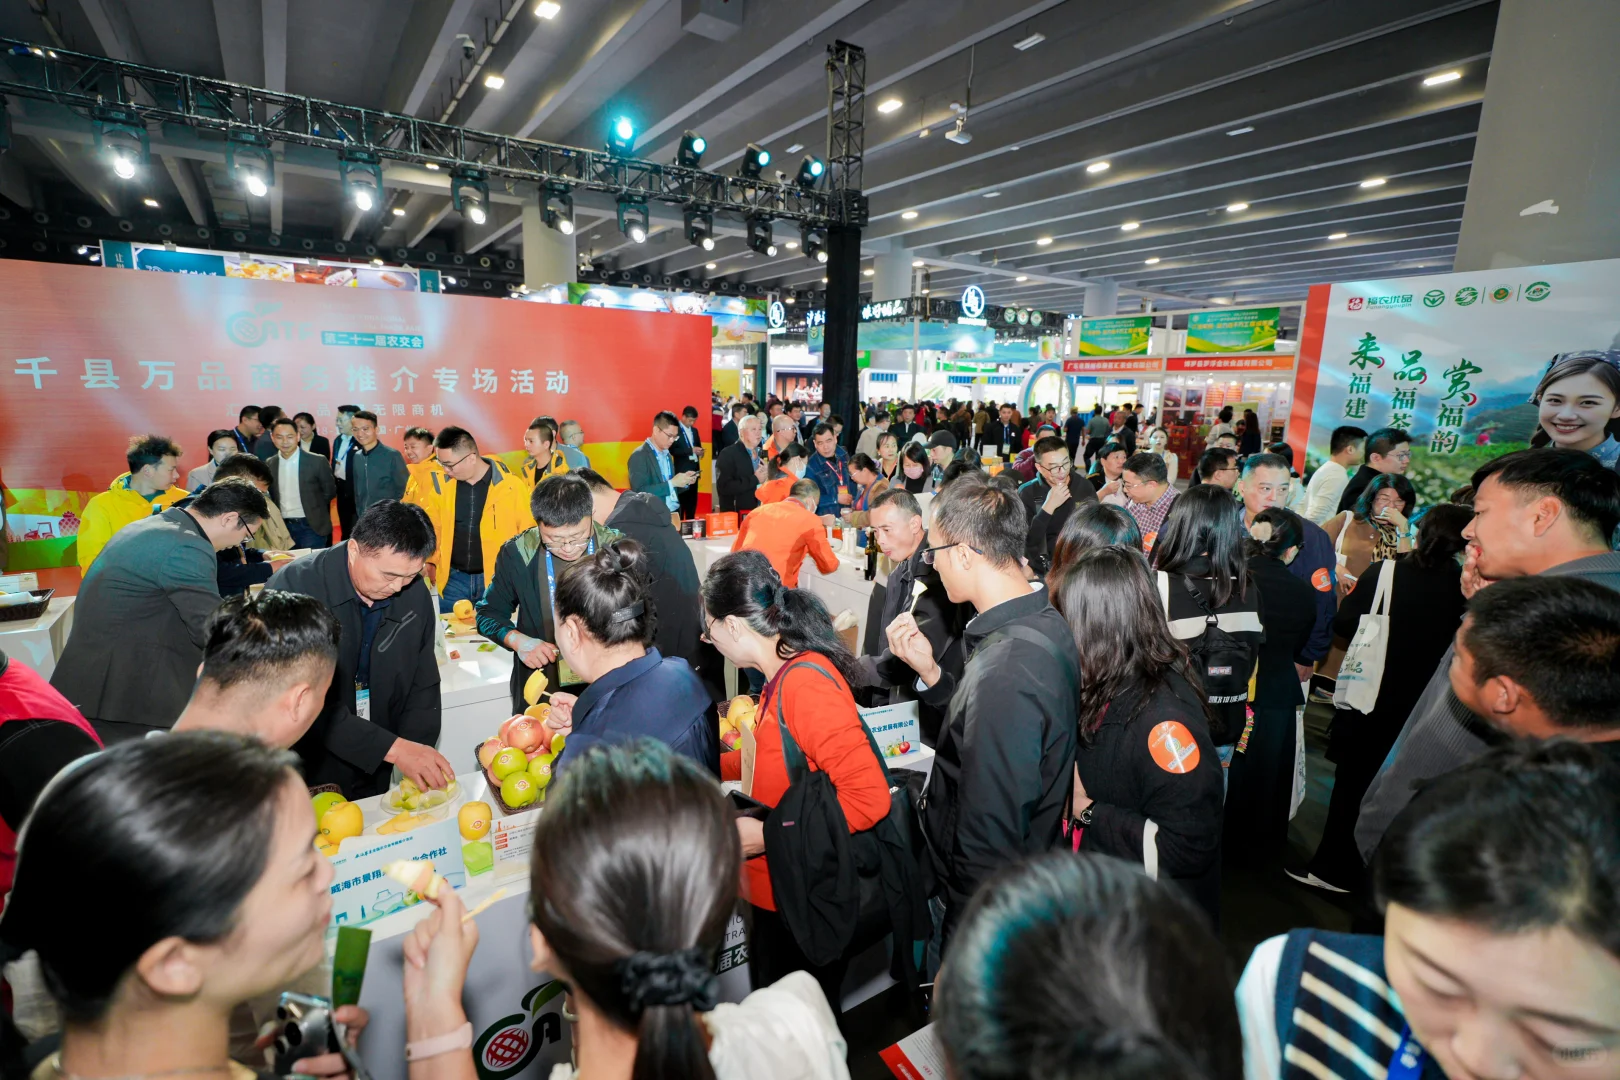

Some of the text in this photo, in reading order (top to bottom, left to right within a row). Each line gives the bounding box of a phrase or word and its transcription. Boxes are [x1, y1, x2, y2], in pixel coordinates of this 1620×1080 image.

[1367, 294, 1413, 305] 福农优品
[323, 331, 424, 348] 第二十一届农交会
[14, 356, 570, 394] 千县万品商务推介专场活动
[1344, 332, 1380, 419] 来福建
[1388, 350, 1424, 429] 品福茶
[1431, 358, 1482, 454] 赏福韵
